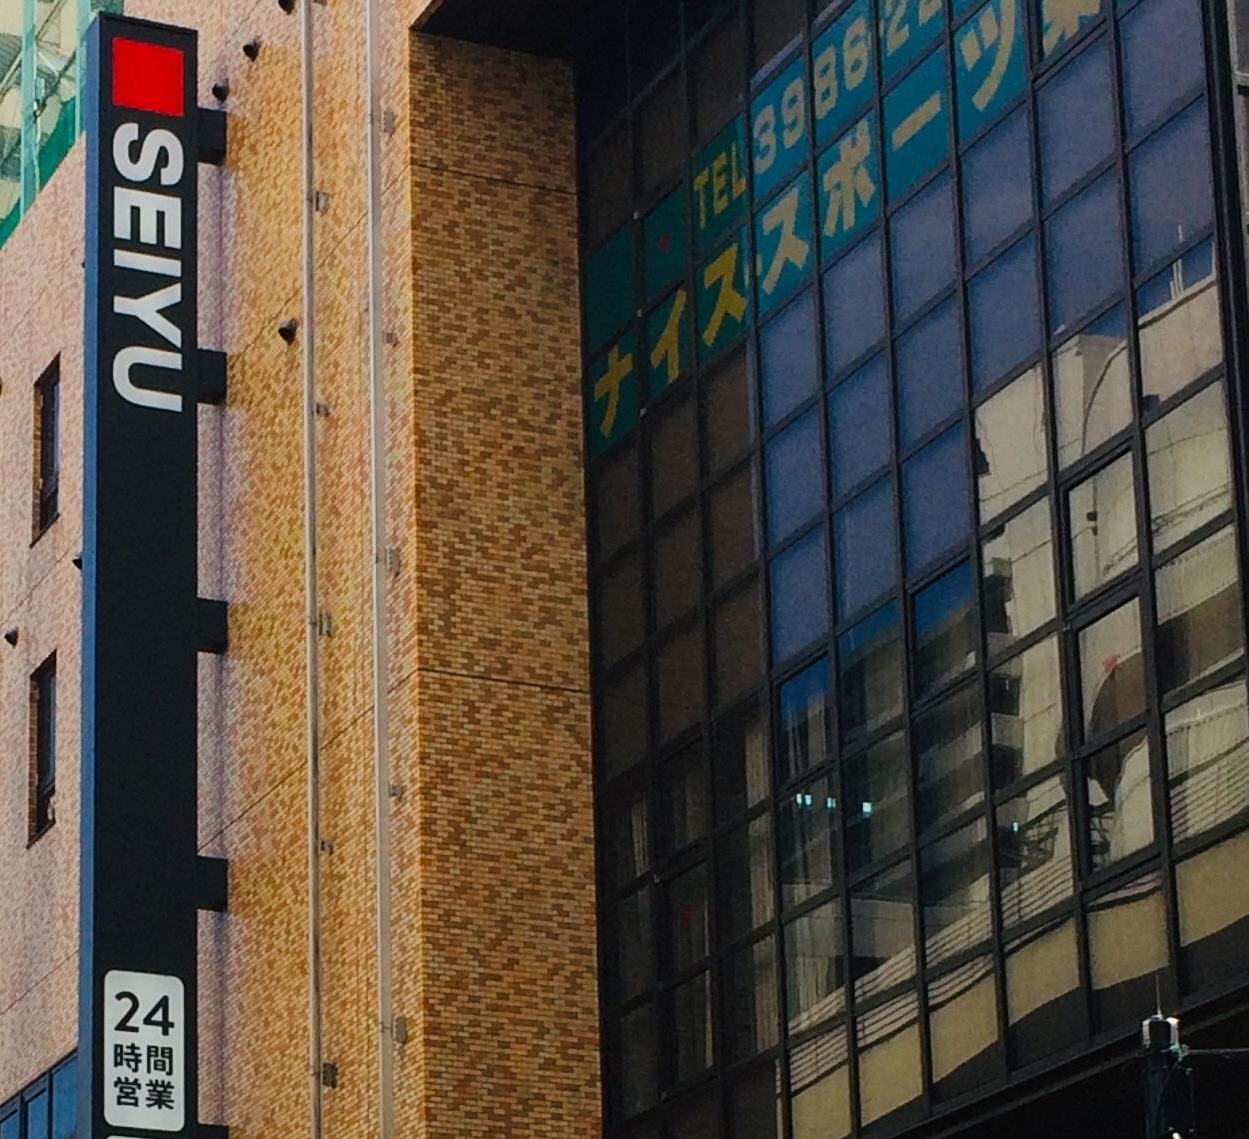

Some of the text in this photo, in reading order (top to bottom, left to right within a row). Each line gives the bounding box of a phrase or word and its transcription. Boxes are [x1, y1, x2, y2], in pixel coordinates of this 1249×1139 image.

[694, 142, 747, 230] TEL
[112, 122, 184, 413] SEIYU
[114, 991, 175, 1037] 24
[113, 1043, 174, 1077] 時間
[114, 1077, 175, 1110] 営業
